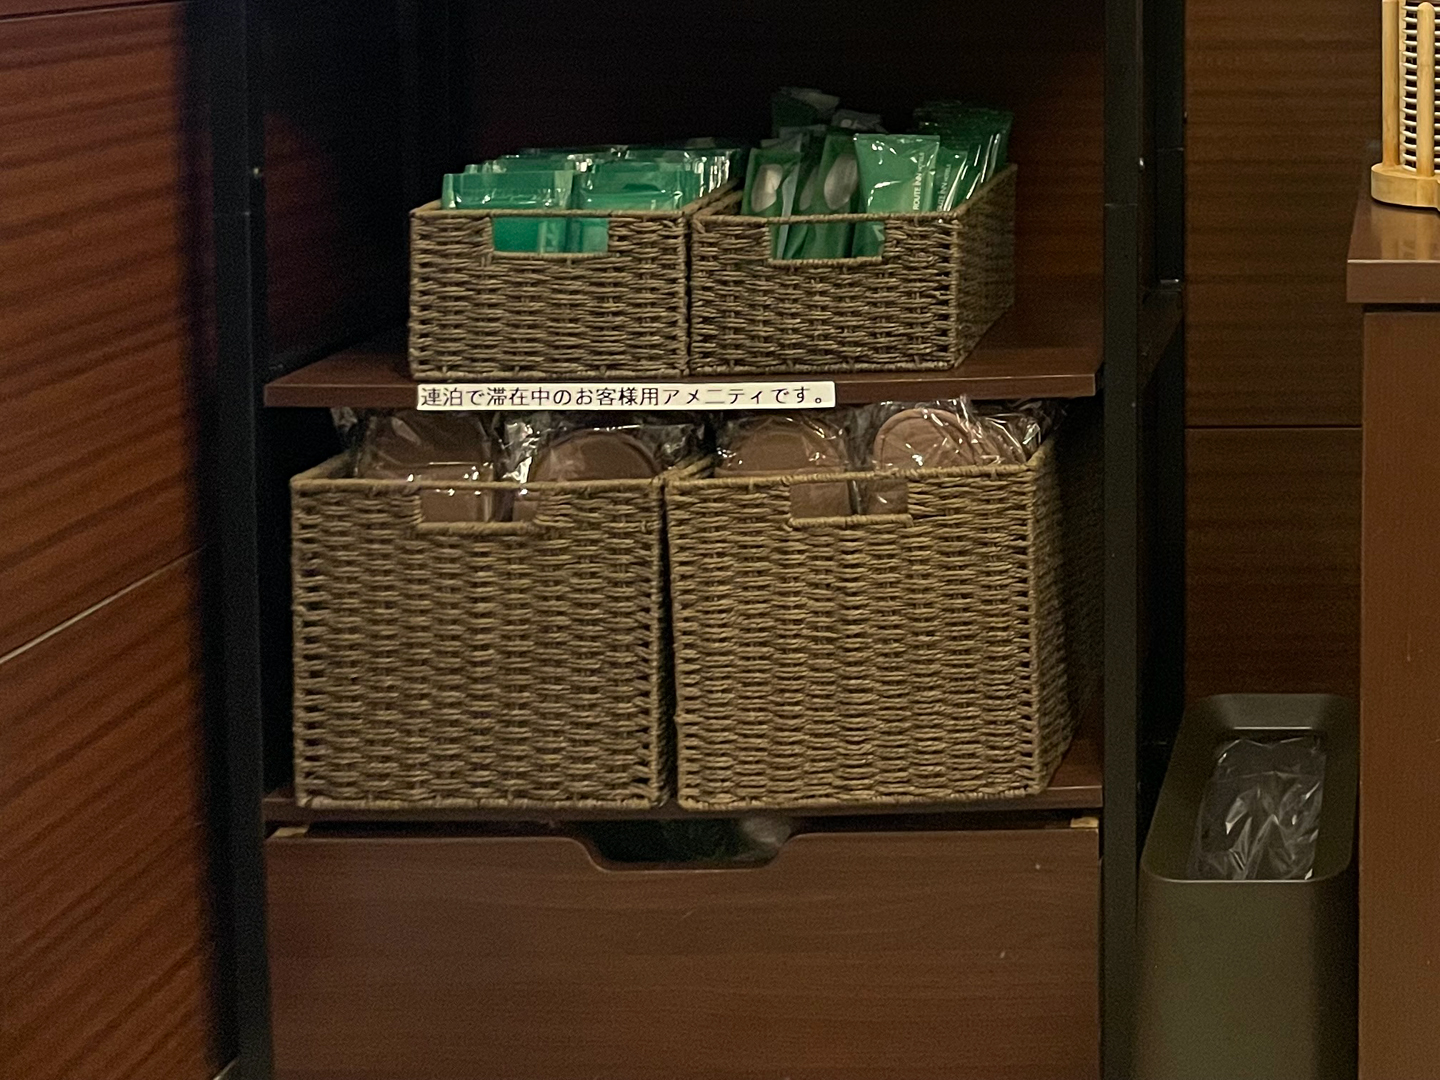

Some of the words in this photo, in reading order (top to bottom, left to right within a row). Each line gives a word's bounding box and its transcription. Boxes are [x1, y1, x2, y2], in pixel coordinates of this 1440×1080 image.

[912, 187, 921, 210] ROUTE
[421, 386, 823, 407] 連泊で滞在中のお客様用アメニティです。
